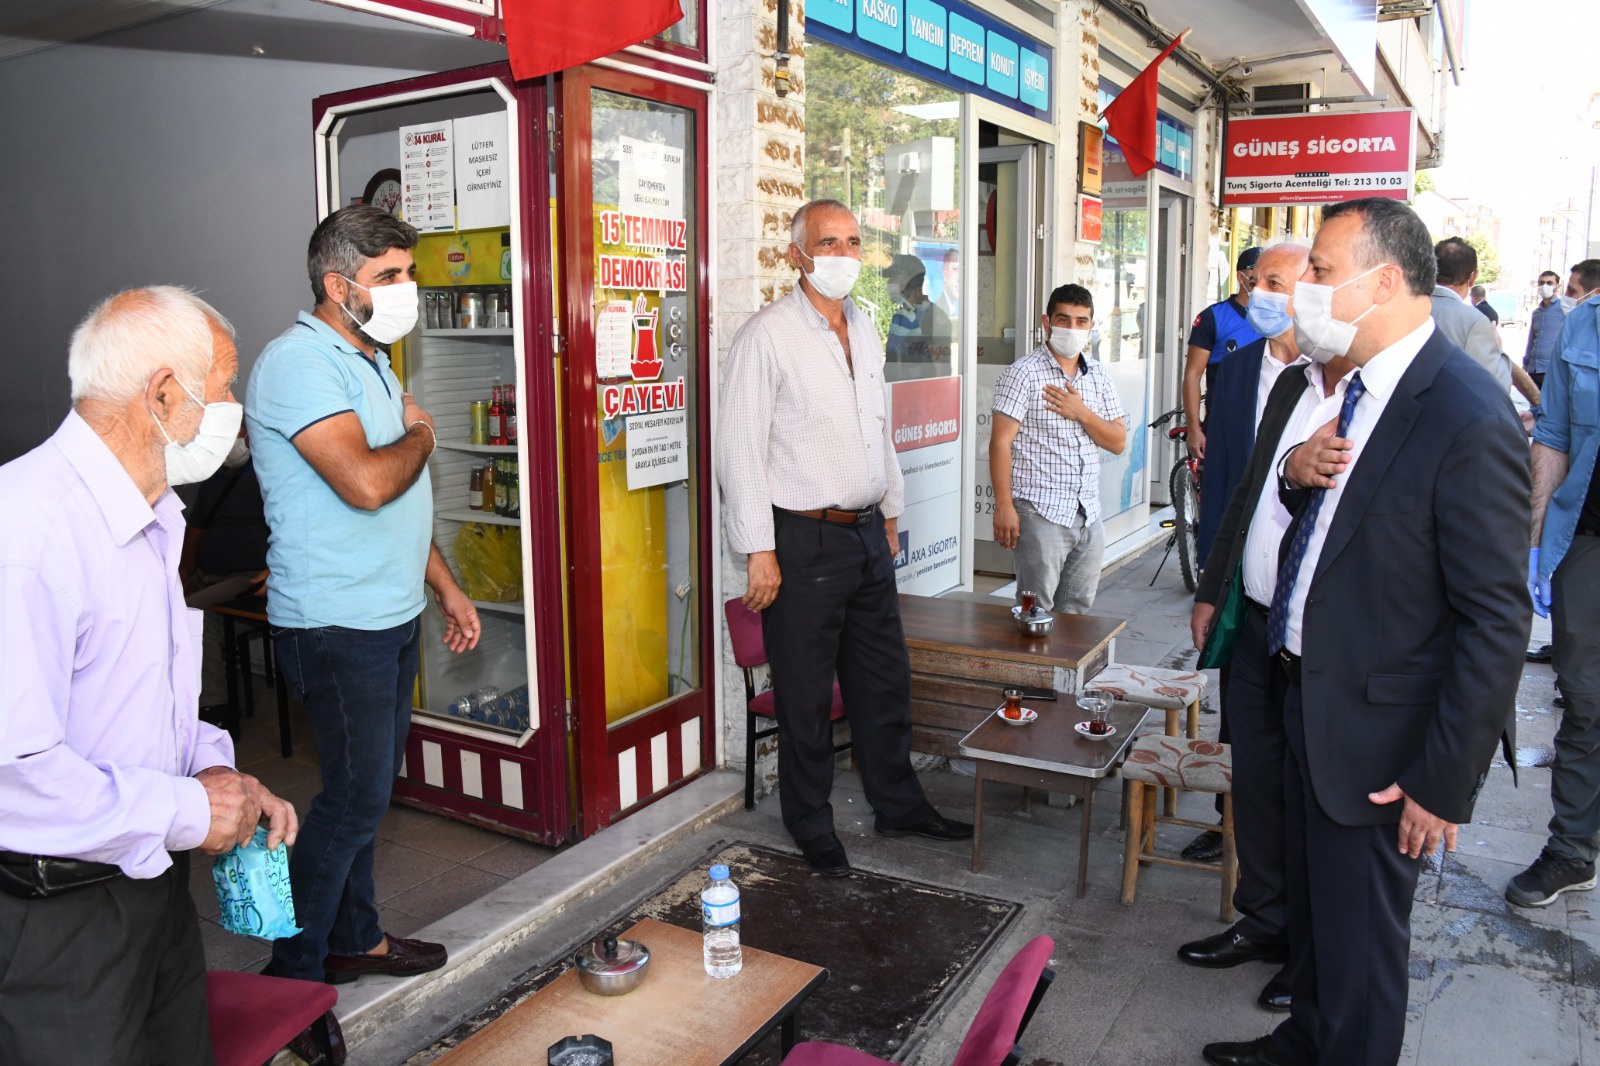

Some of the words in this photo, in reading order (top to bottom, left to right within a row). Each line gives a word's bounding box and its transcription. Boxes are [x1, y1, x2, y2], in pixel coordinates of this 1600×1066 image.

[862, 0, 898, 28] KASKO
[910, 14, 944, 48] YANGIN
[950, 33, 984, 65] DEPREM
[990, 52, 1015, 78] KONUT
[1024, 64, 1046, 92] İŞYERİ
[414, 136, 422, 146] 14
[422, 132, 446, 144] KURAL
[472, 140, 494, 150] LÜTFEN
[1233, 138, 1300, 159] GÜNEŞ
[1306, 135, 1396, 154] SİGORTA
[468, 154, 498, 164] MASKESİZ
[476, 166, 491, 178] İÇERİ
[1227, 182, 1248, 192] Tunç
[1250, 180, 1282, 190] Sigorta
[1285, 178, 1331, 189] Acenteliği
[1334, 178, 1351, 186] Tel:
[1354, 178, 1372, 186] 213
[1376, 178, 1386, 186] 10
[1390, 177, 1402, 185] 03
[466, 180, 502, 192] GİRMEYİNİZ
[602, 212, 620, 242] 15
[624, 215, 686, 248] TEMMUZ
[601, 257, 685, 290] DEMOKRASİ
[604, 378, 684, 417] ÇAYEVİ
[894, 424, 922, 444] GÜNEŞ
[925, 419, 958, 438] SİGORTA
[911, 548, 926, 564] AXA
[928, 536, 957, 557] SİGORTA
[916, 565, 933, 578] yeniden
